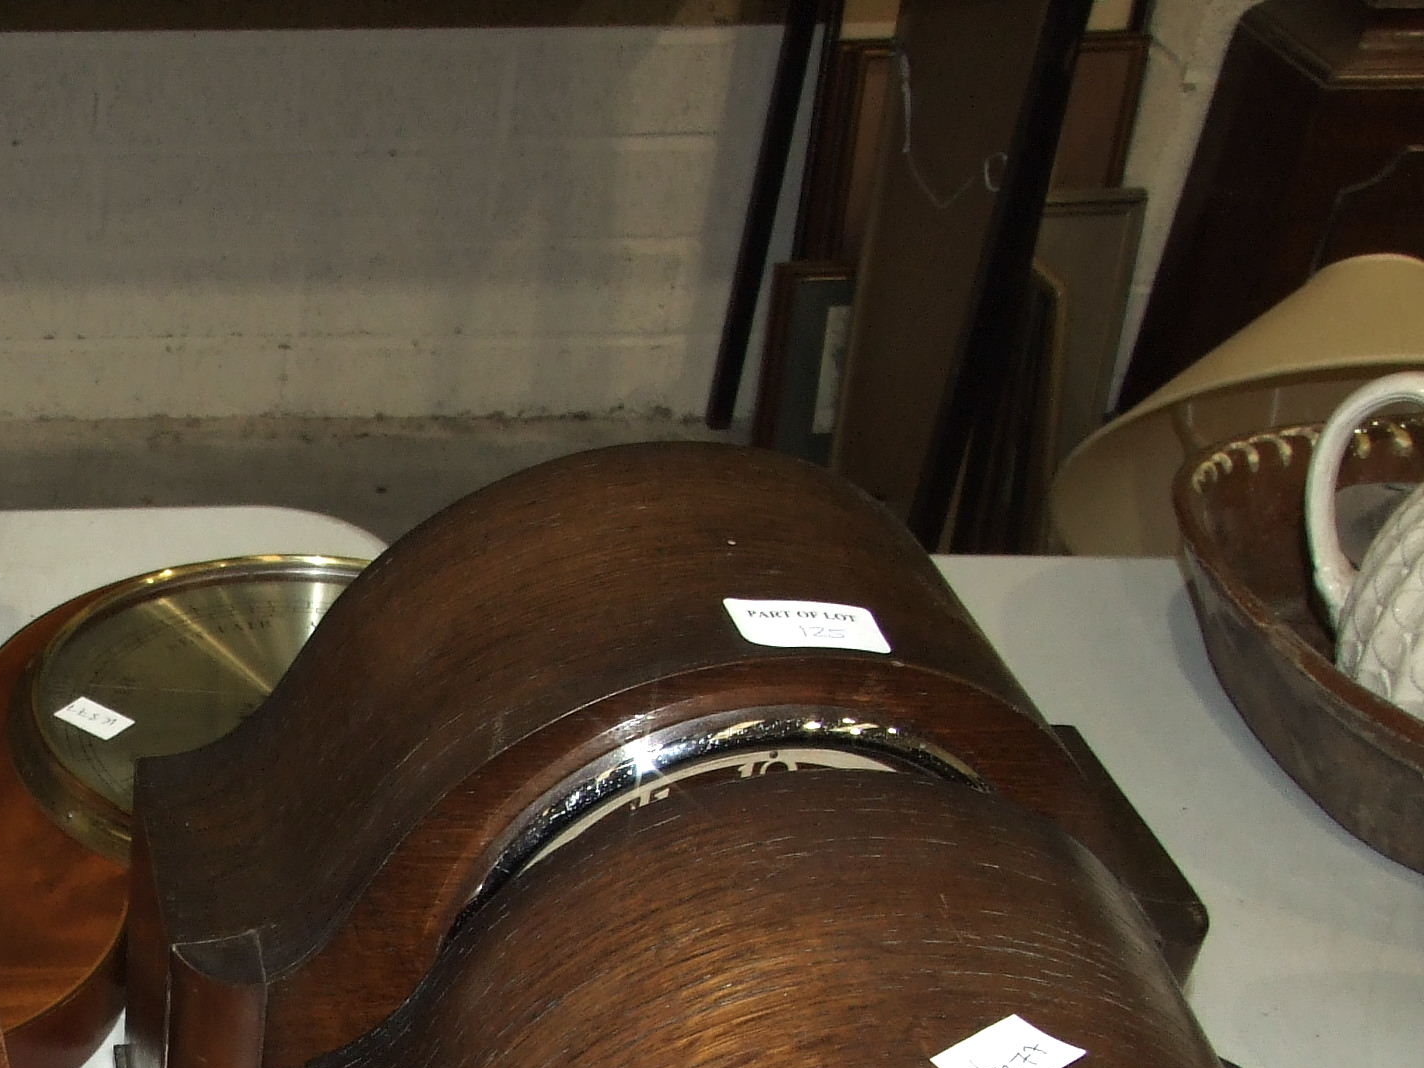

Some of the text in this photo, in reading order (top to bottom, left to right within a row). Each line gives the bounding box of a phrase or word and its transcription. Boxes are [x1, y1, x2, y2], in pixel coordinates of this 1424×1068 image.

[747, 608, 857, 623] PART OF LOT
